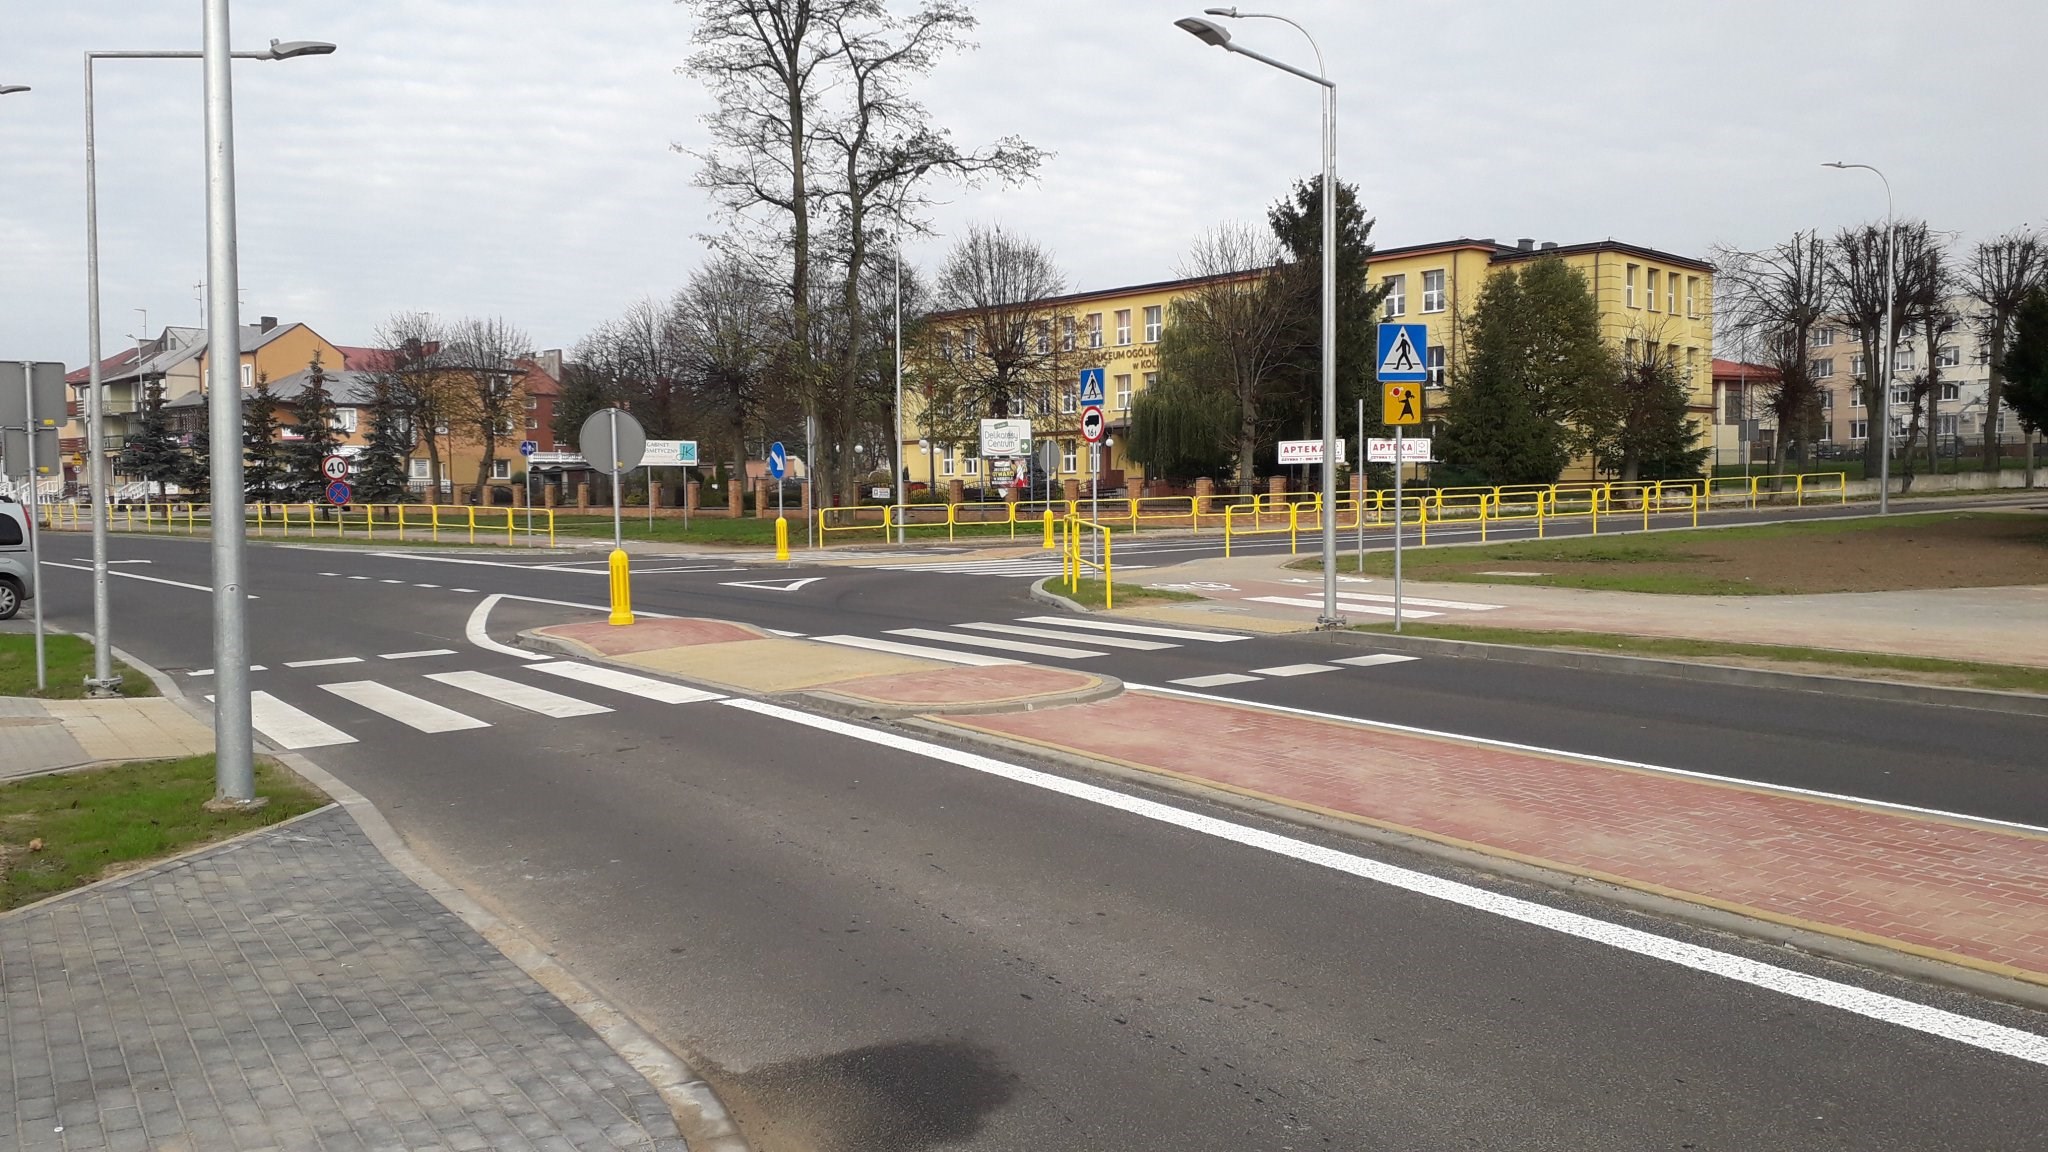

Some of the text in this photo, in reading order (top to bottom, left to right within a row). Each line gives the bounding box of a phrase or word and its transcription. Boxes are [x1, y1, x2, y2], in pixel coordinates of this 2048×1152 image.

[985, 431, 1019, 441] Delikatesy
[988, 440, 1015, 448] Centrum
[1373, 443, 1413, 451] APTEKA
[1283, 445, 1325, 454] APTEKA
[327, 461, 345, 474] 40
